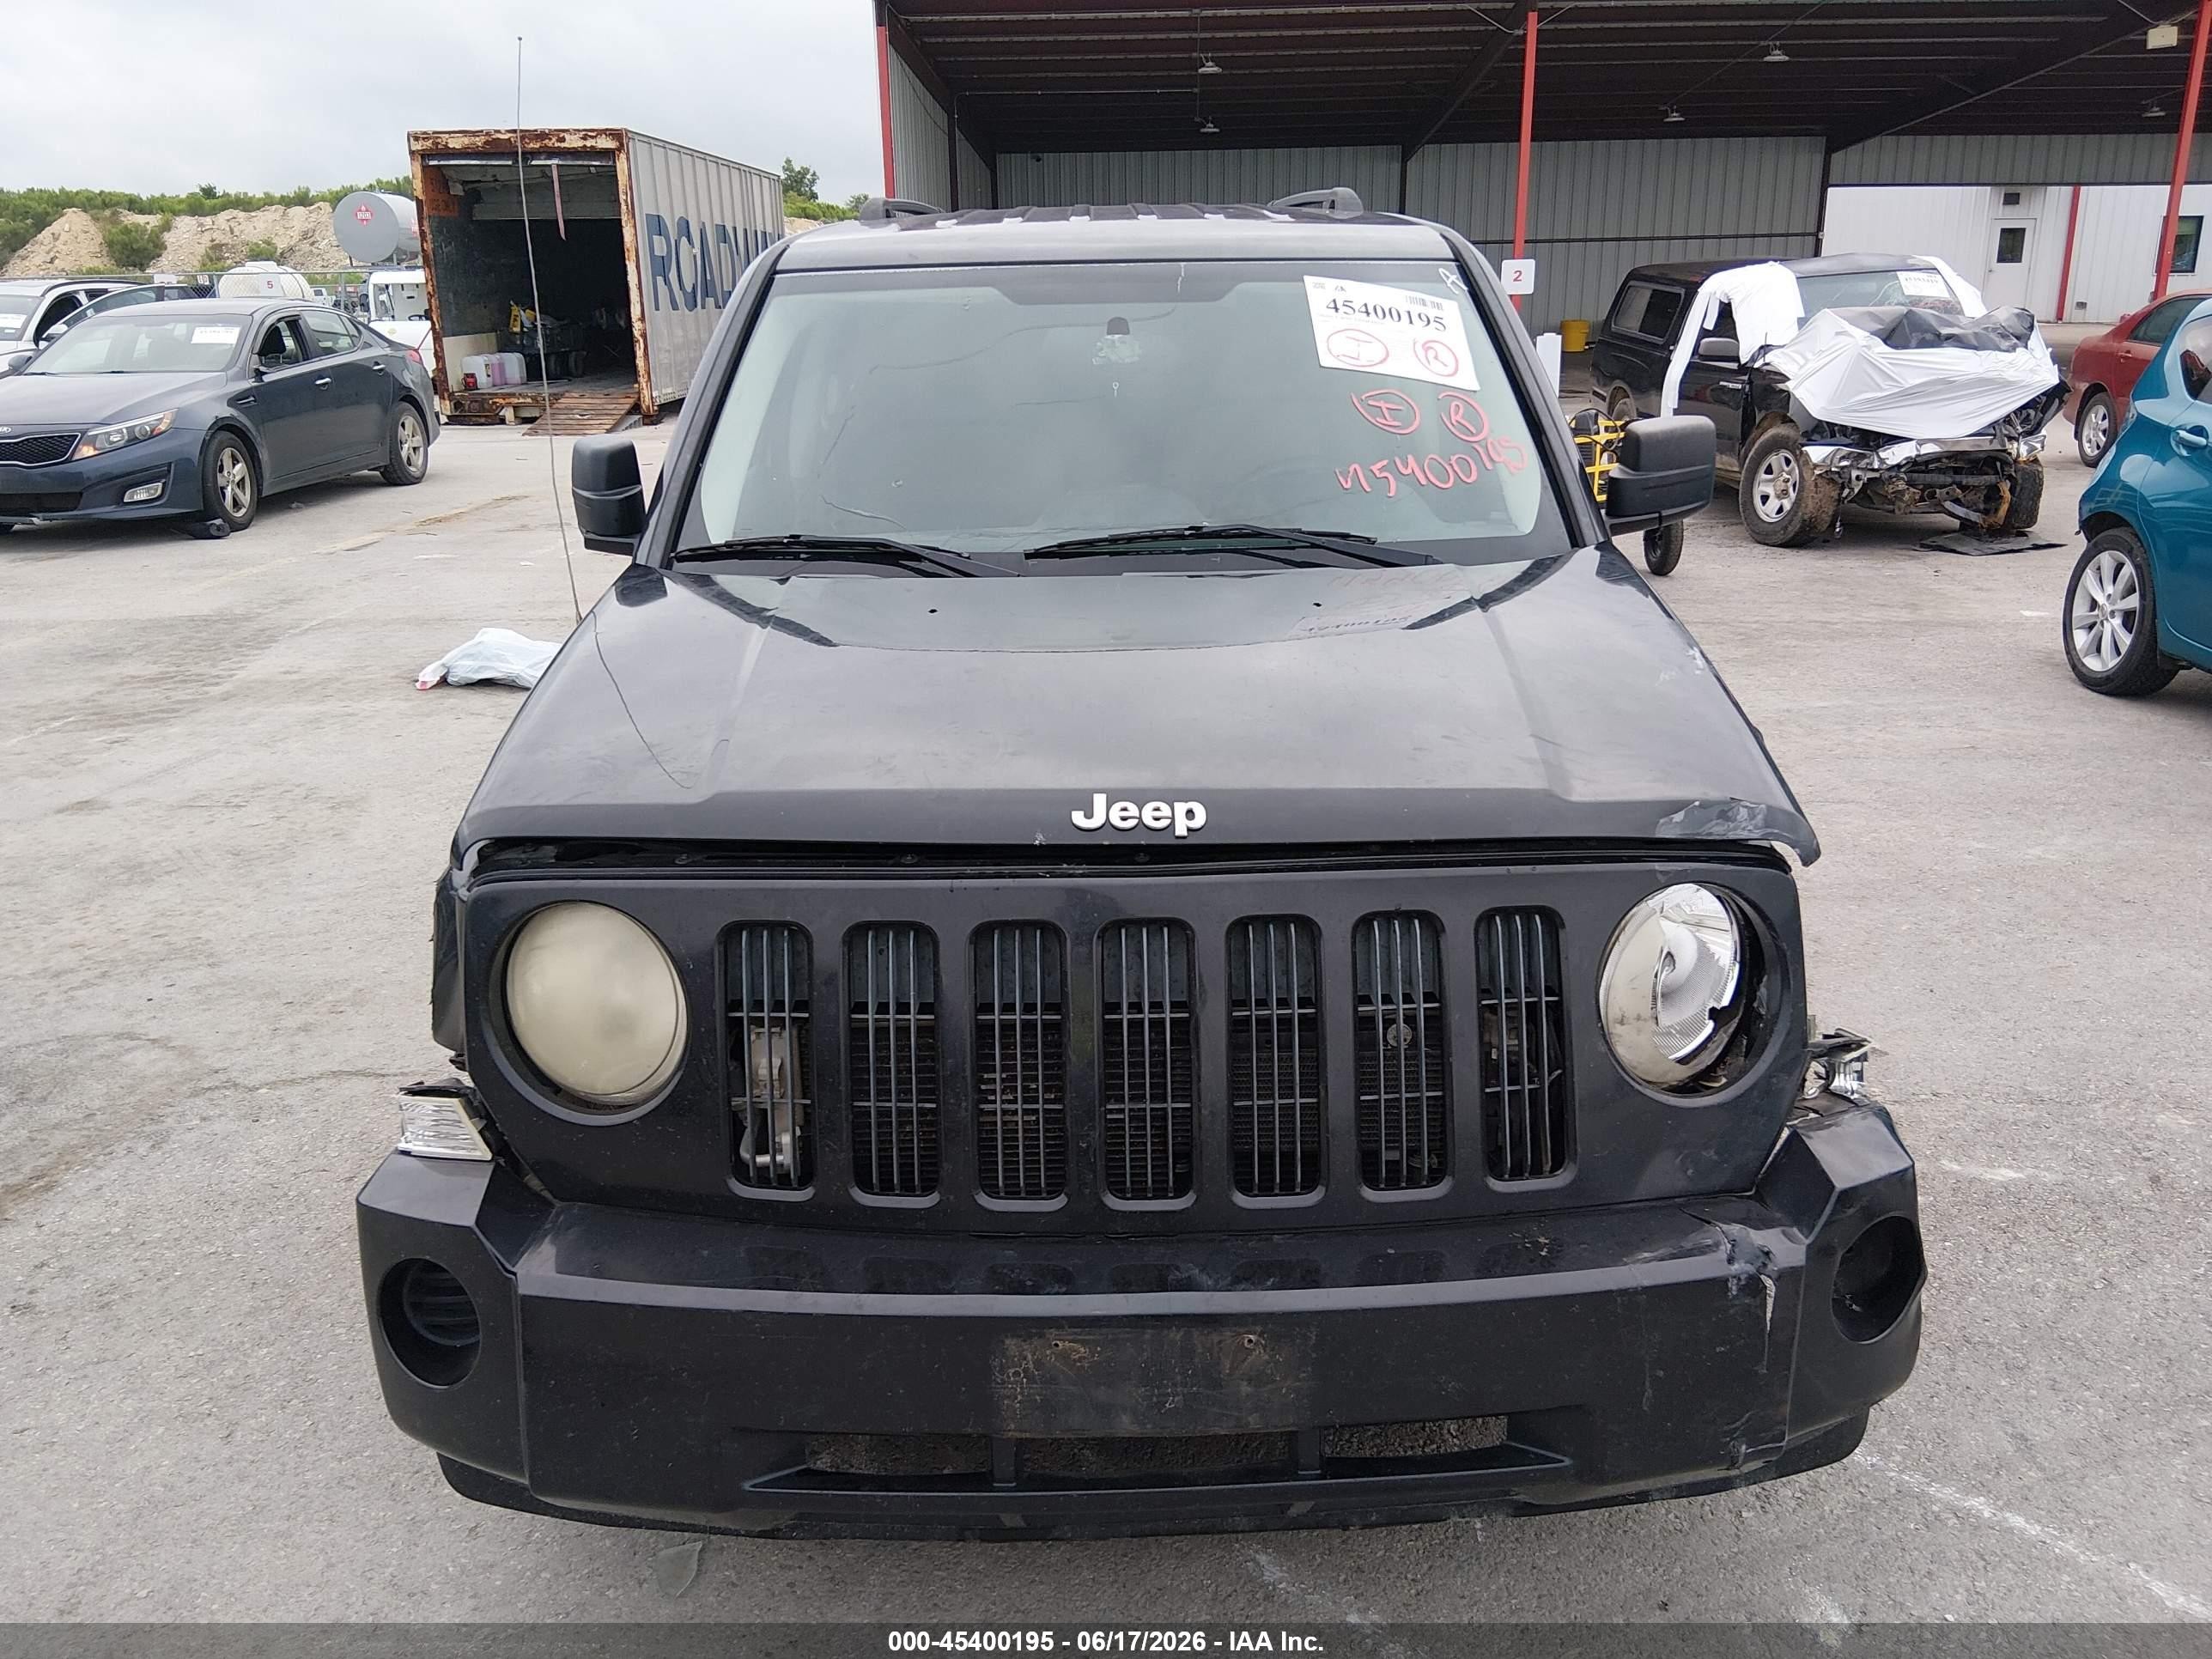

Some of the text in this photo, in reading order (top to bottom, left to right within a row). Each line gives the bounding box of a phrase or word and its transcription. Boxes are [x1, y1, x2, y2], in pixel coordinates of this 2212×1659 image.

[645, 213, 784, 312] ROAD
[1513, 270, 1522, 282] 2
[1326, 298, 1447, 331] 45400195
[1071, 793, 1206, 838] Jeep
